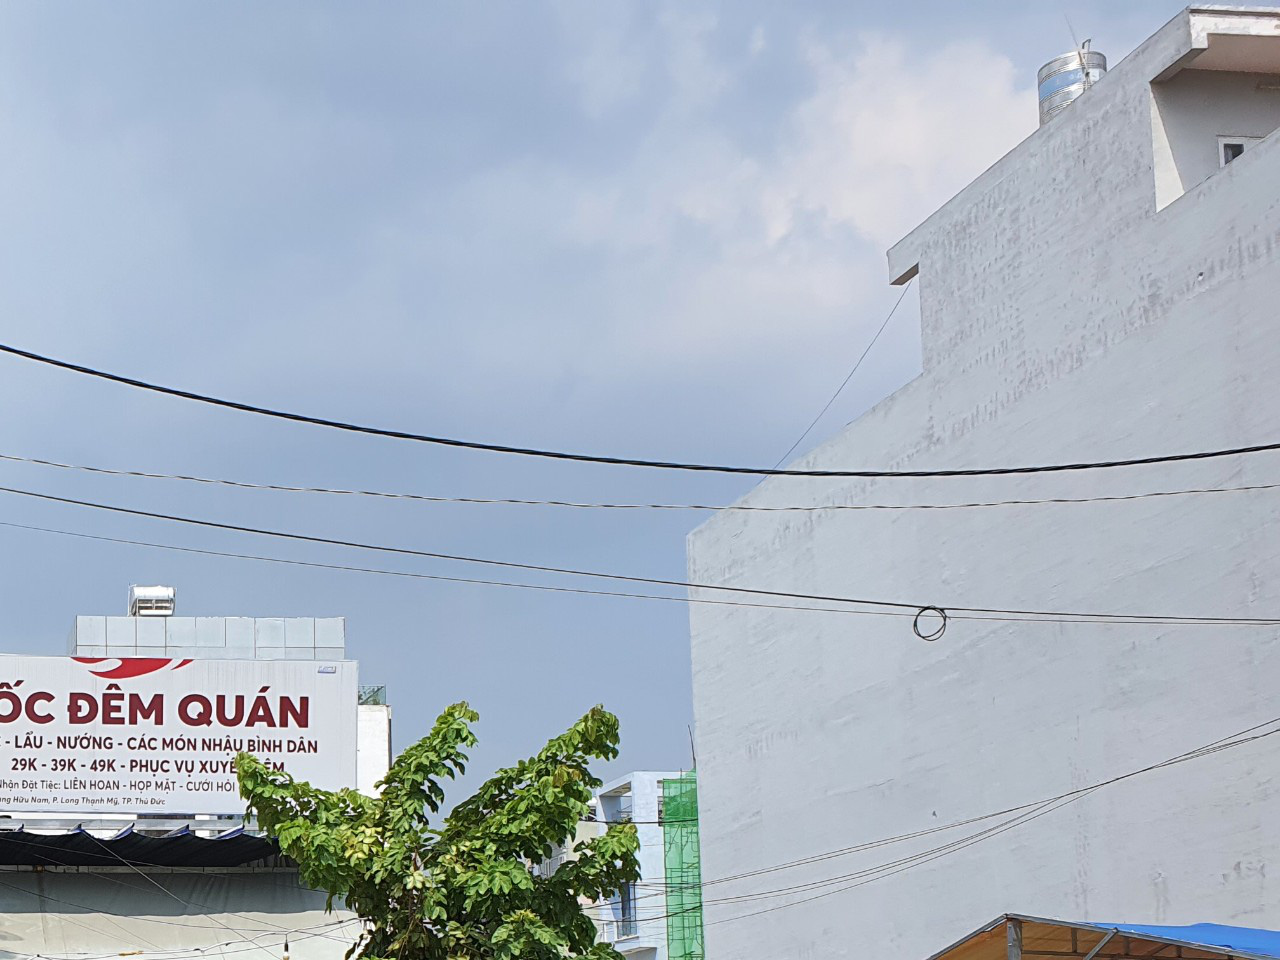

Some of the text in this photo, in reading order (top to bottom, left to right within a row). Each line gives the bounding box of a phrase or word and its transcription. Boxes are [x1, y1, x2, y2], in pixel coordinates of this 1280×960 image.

[67, 683, 164, 725] ĐÊM
[178, 686, 309, 728] QUÁN
[14, 731, 43, 749] LẨU
[56, 733, 114, 750] NƯỚNG
[127, 733, 158, 750] CÁC
[162, 734, 197, 751] MÓN
[201, 735, 243, 756] NHẬU
[247, 736, 282, 752] BÌNH
[287, 736, 318, 753] DÂN
[11, 758, 37, 771] 29K
[50, 759, 77, 772] 39K
[90, 759, 116, 772] 49K
[129, 759, 170, 777] PHỤC
[174, 760, 195, 777] VỤ
[199, 757, 238, 774] XUYÊ
[22, 779, 38, 792] Đặt
[41, 779, 61, 792] Tiệc:
[63, 777, 86, 790] LIÊN
[89, 780, 120, 790] HOAN
[130, 780, 151, 793] HỌP
[155, 779, 176, 794] MẶT
[186, 779, 213, 792] CƯỚI
[13, 795, 29, 803] Hữu
[31, 796, 50, 804] Nam,
[61, 797, 79, 805] Long
[81, 797, 105, 806] Thạnh
[150, 797, 165, 805] Đức
